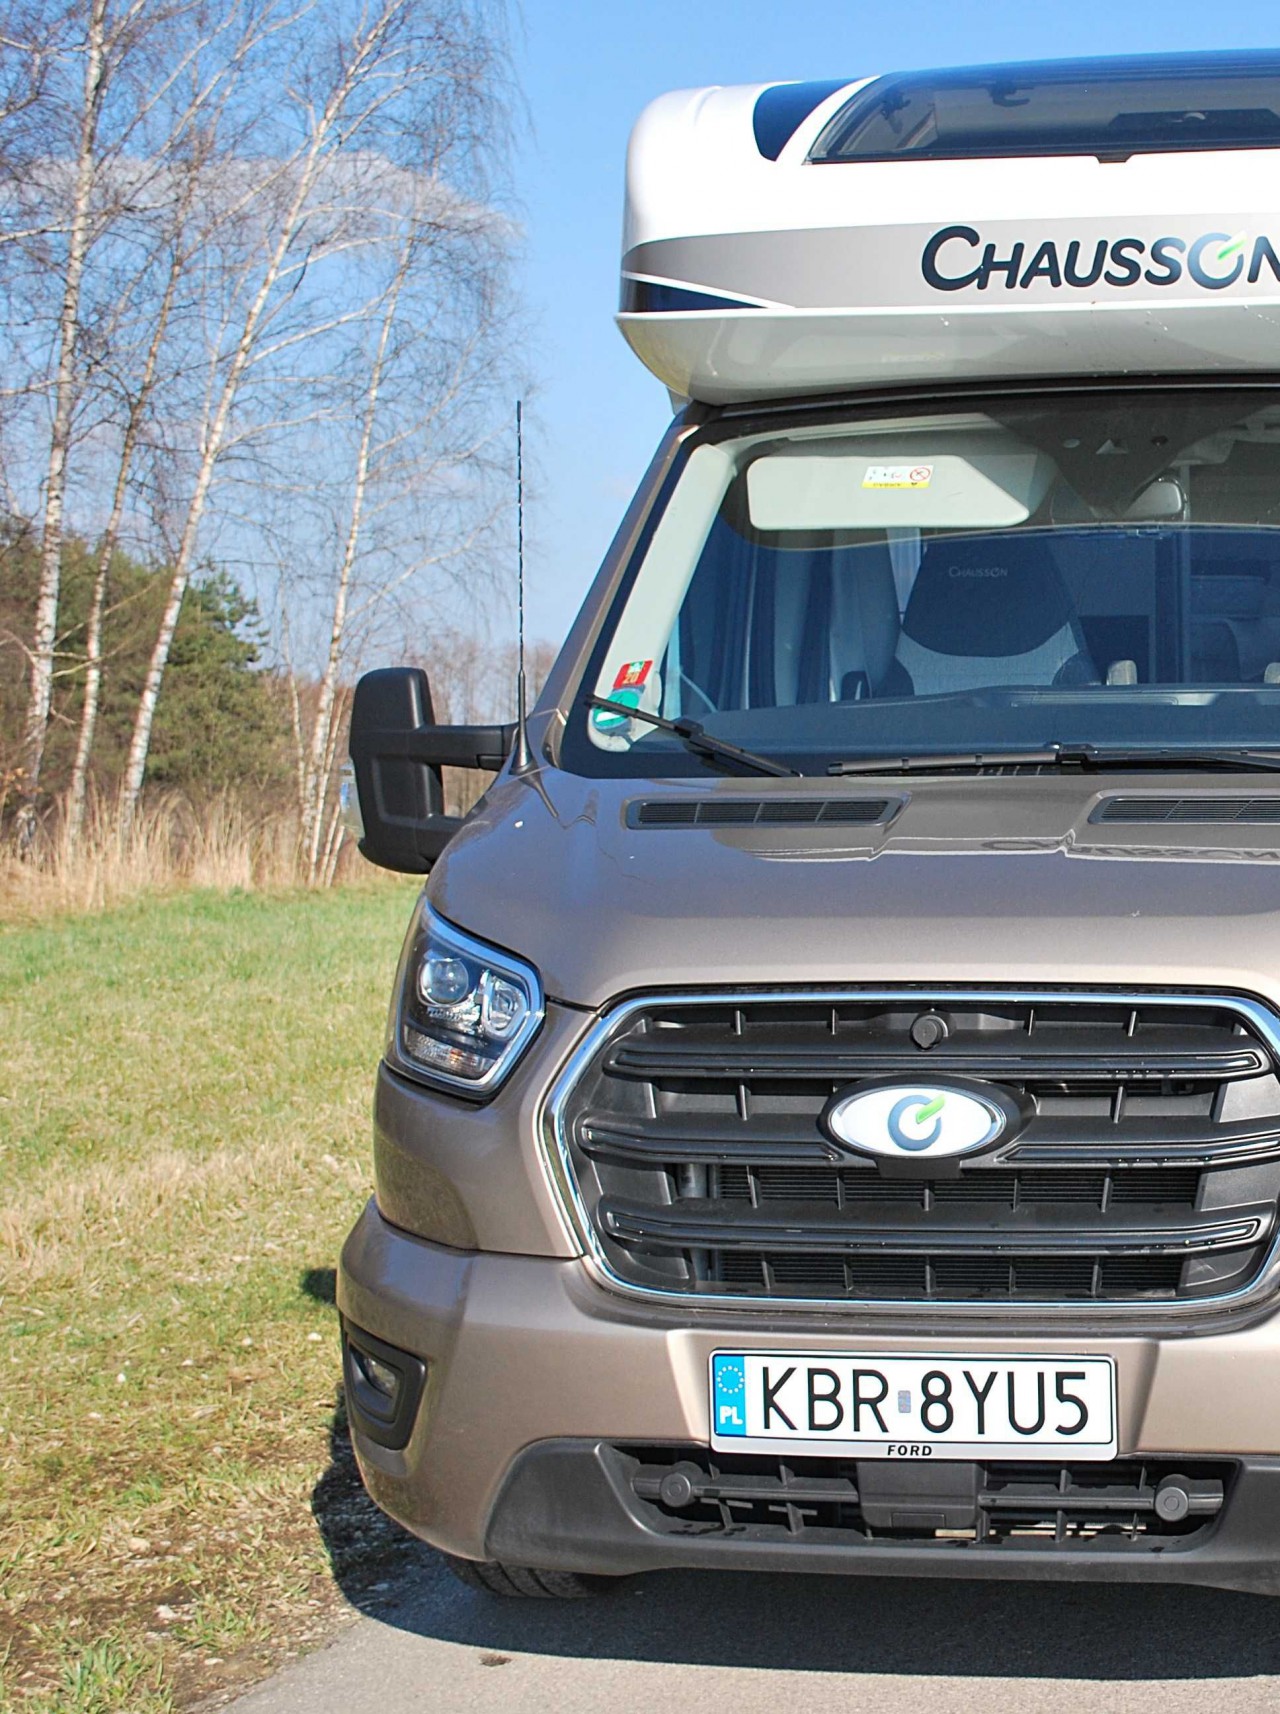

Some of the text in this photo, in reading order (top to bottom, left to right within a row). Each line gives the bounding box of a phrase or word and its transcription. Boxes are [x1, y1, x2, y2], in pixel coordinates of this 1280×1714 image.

[763, 1366, 1089, 1435] KBR 8YU5
[719, 1405, 743, 1425] PL
[887, 1444, 934, 1456] FORD
